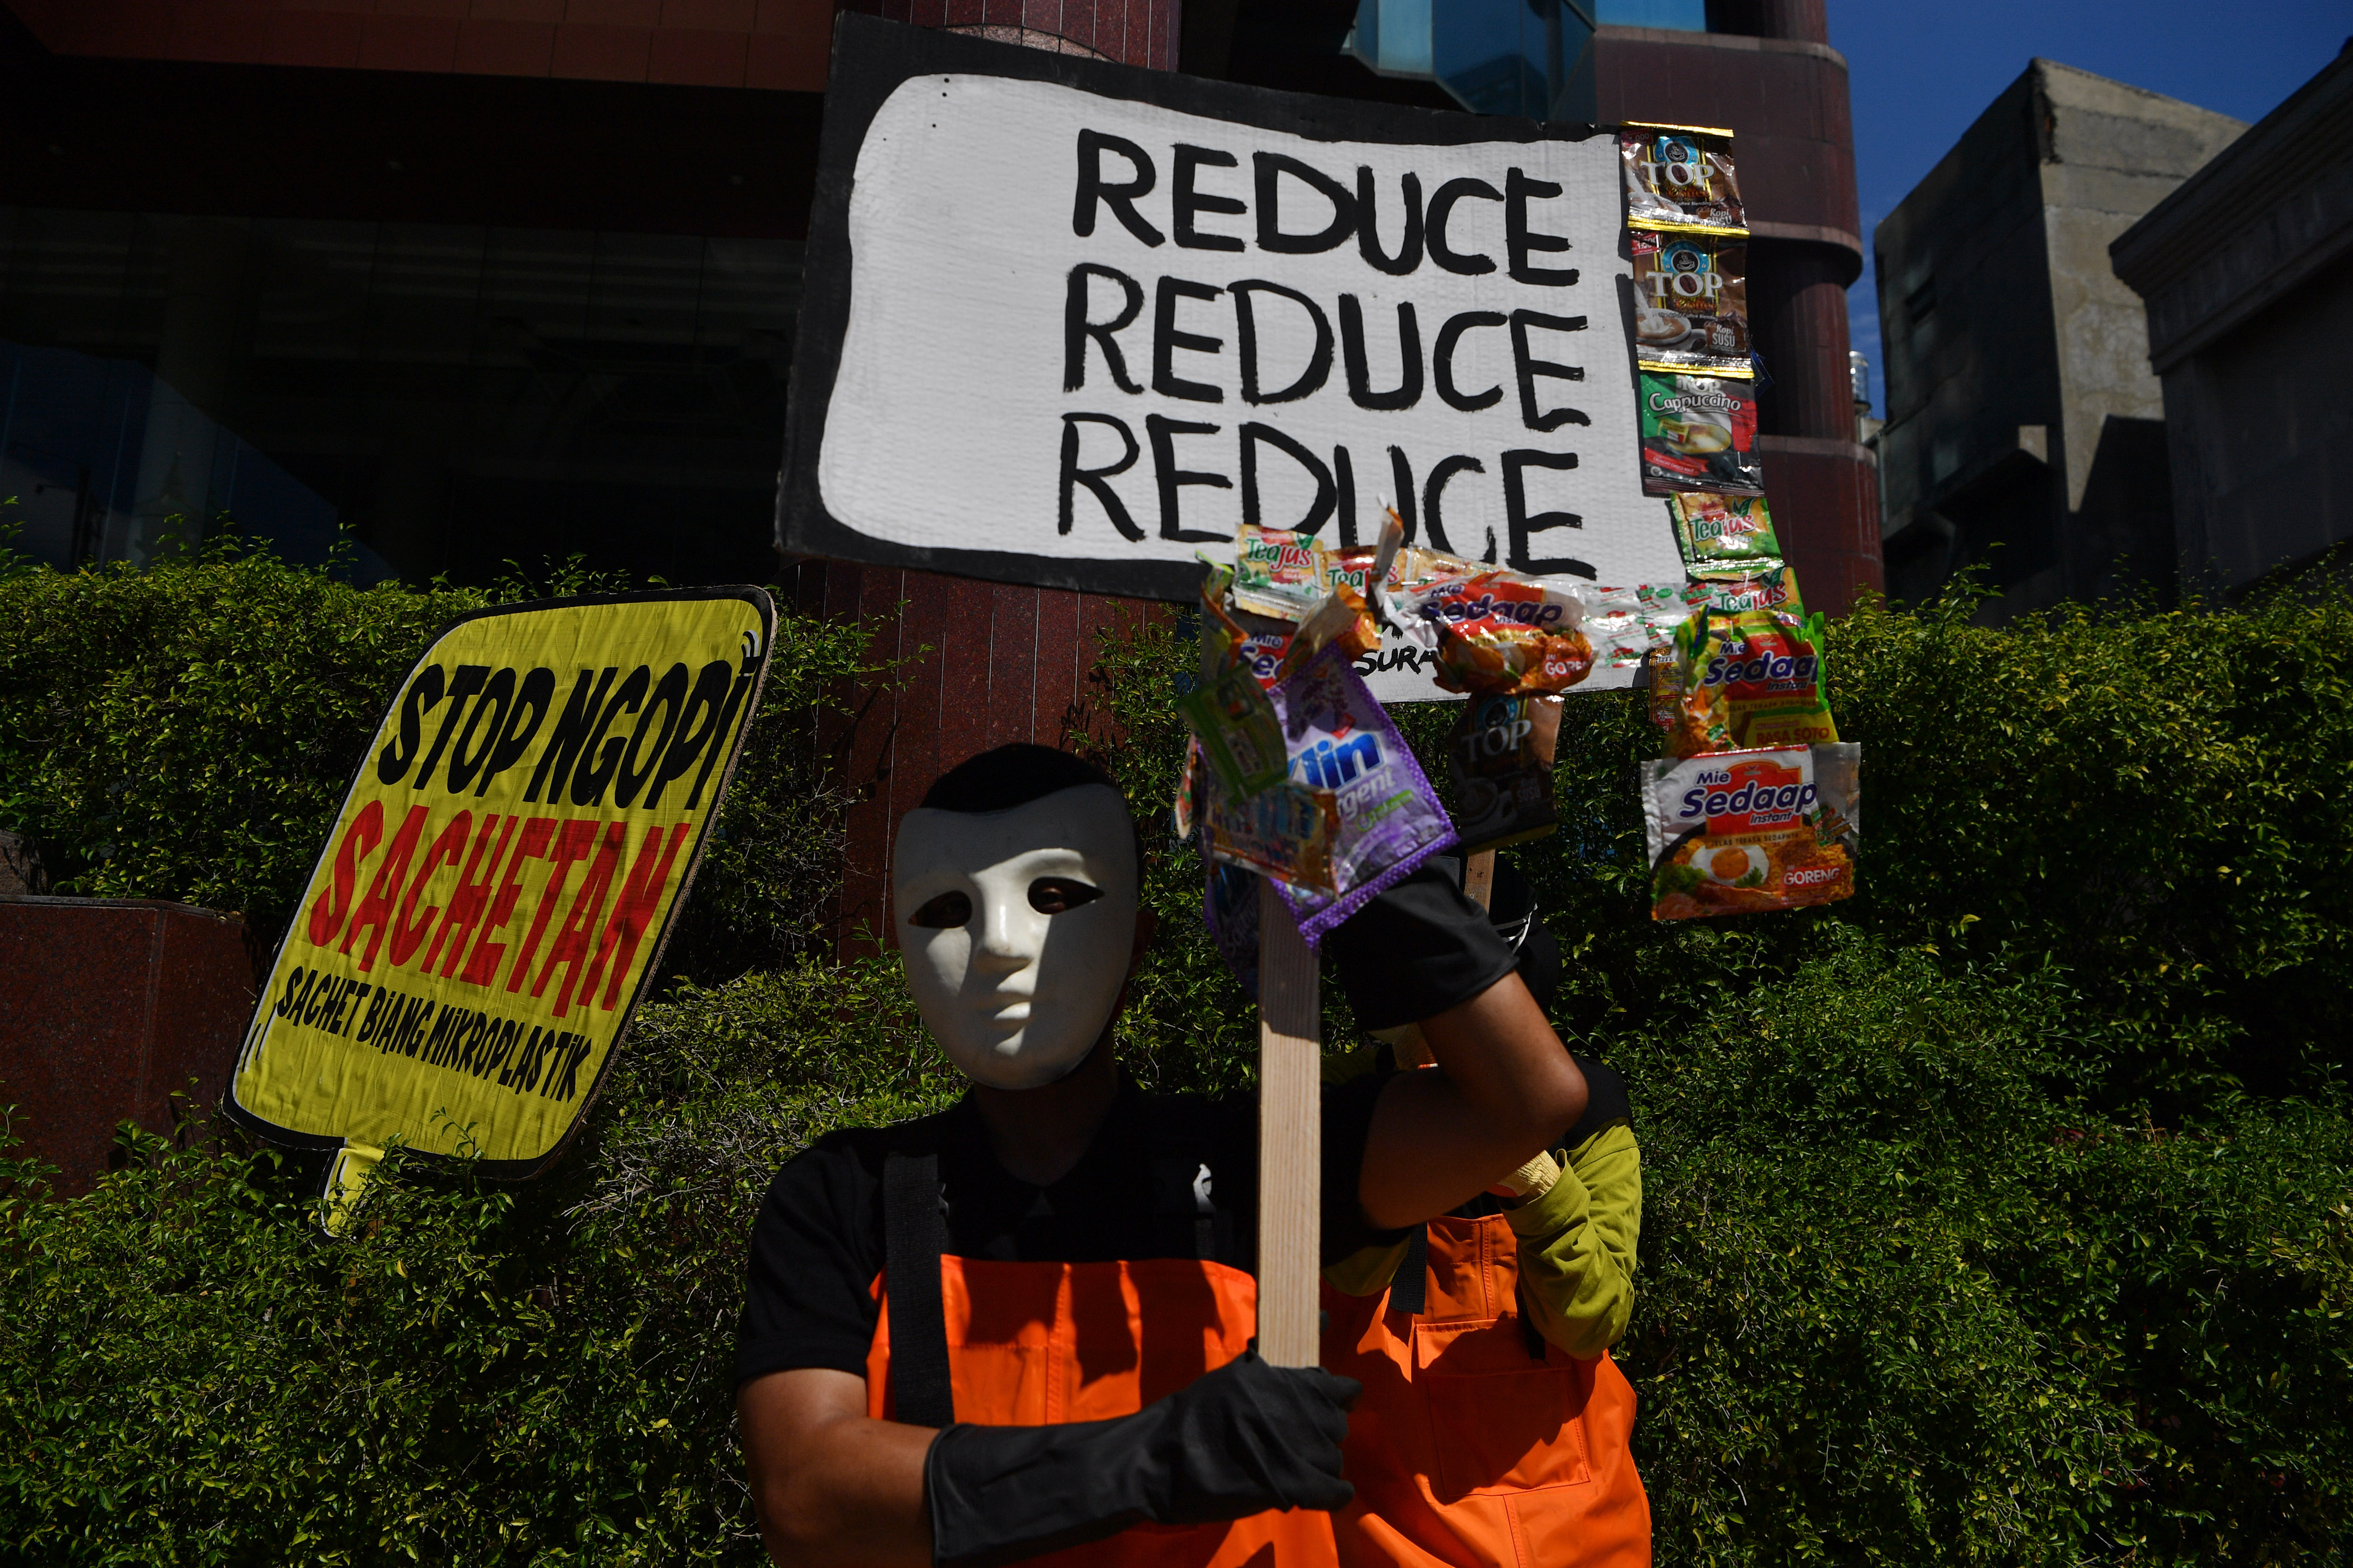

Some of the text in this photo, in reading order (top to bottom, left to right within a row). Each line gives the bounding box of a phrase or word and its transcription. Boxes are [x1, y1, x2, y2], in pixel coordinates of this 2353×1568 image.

[1639, 161, 1715, 186] TOP
[1072, 128, 1580, 286] REDUCE
[1710, 208, 1729, 218] Kopi
[1645, 271, 1724, 298] TOP
[1712, 333, 1735, 347] SUSU
[1717, 324, 1734, 335] Kopi
[1064, 262, 1592, 432] REDUCE
[1649, 392, 1741, 412] Cappuccino
[1058, 411, 1597, 581] REDUCE
[1245, 538, 1312, 572] Teajus
[1327, 565, 1400, 598] Teajs
[1421, 593, 1564, 627] Sedaap
[376, 663, 555, 798] STOP
[1459, 719, 1532, 762] TOP
[1757, 727, 1830, 745] RASA SOTO
[1337, 766, 1396, 821] rgent
[1696, 770, 1731, 785] Mie
[1678, 781, 1818, 818] Sedaap
[1749, 811, 1794, 825] Instant
[1783, 868, 1841, 885] GORENG
[309, 800, 691, 1018] SACHETAN
[277, 966, 372, 1037] SACHET
